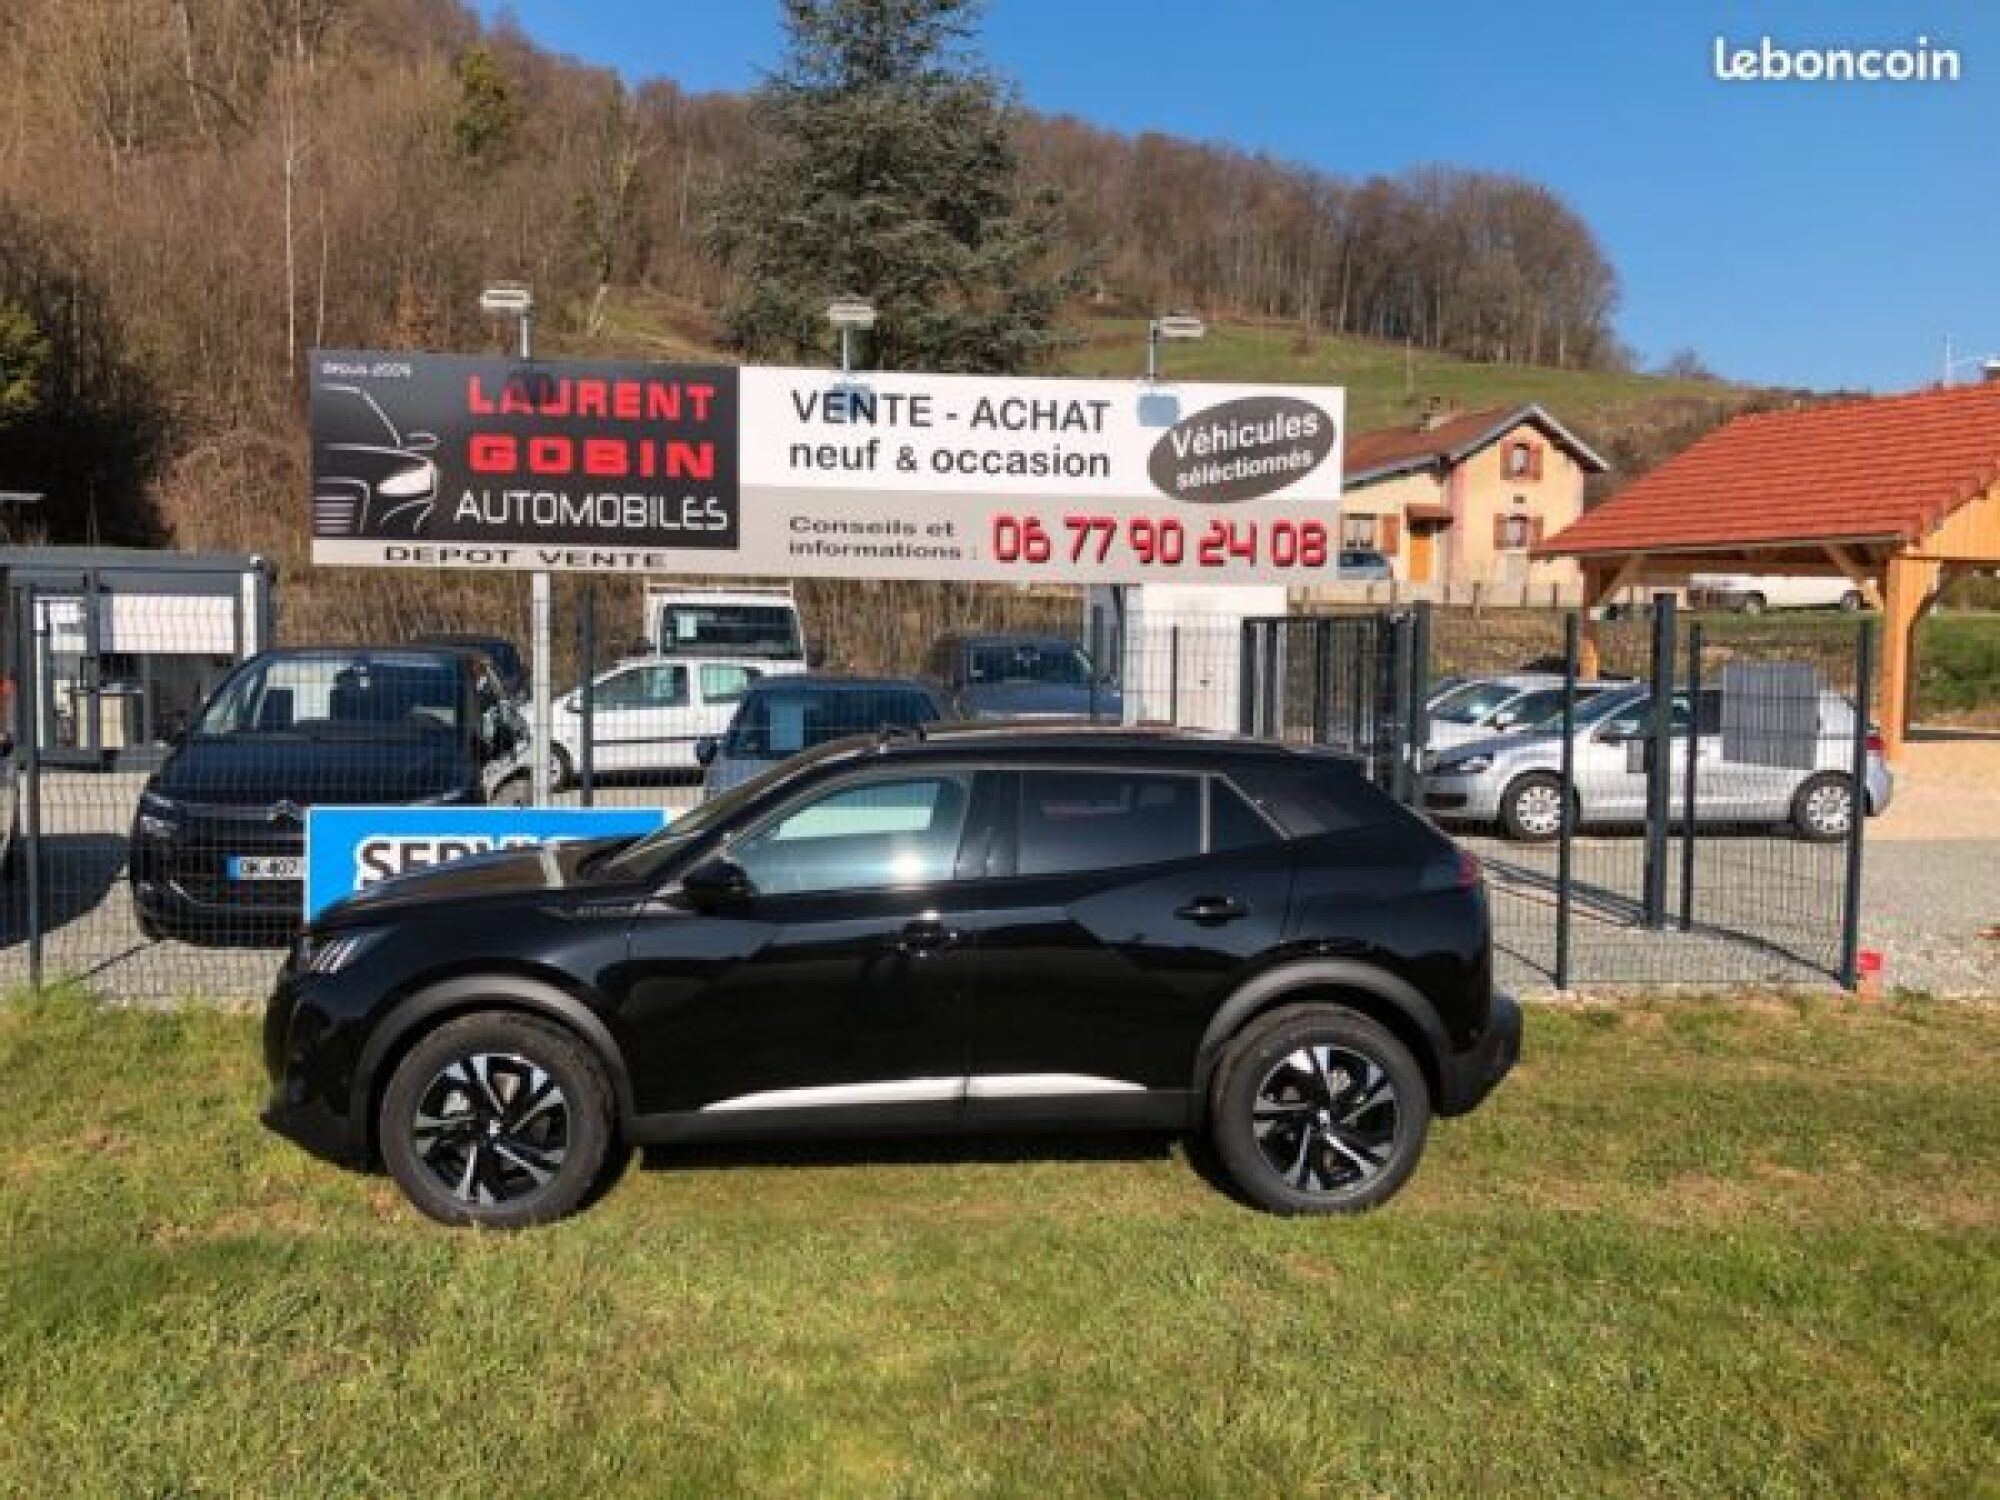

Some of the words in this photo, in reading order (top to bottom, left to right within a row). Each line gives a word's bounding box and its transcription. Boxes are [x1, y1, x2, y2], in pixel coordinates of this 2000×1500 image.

[467, 376, 714, 420] LAURENT
[791, 389, 932, 428] VENTE
[970, 396, 1111, 432] ACHAT
[469, 434, 714, 477] GOBIN
[1170, 411, 1321, 460] Véhicules
[790, 438, 880, 470] neuf
[896, 446, 918, 473] &
[932, 444, 1110, 478] occasion
[453, 490, 728, 532] AUTOMOBILES
[789, 516, 918, 537] Conseils
[926, 520, 955, 537] et
[386, 546, 517, 563] DEPOT
[538, 550, 667, 567] VENTE
[789, 539, 962, 560] informations
[993, 516, 1052, 564] 06
[1063, 517, 1118, 564] 77
[1128, 518, 1186, 566] 90
[1199, 519, 1258, 567] 24
[1270, 520, 1328, 568] 08
